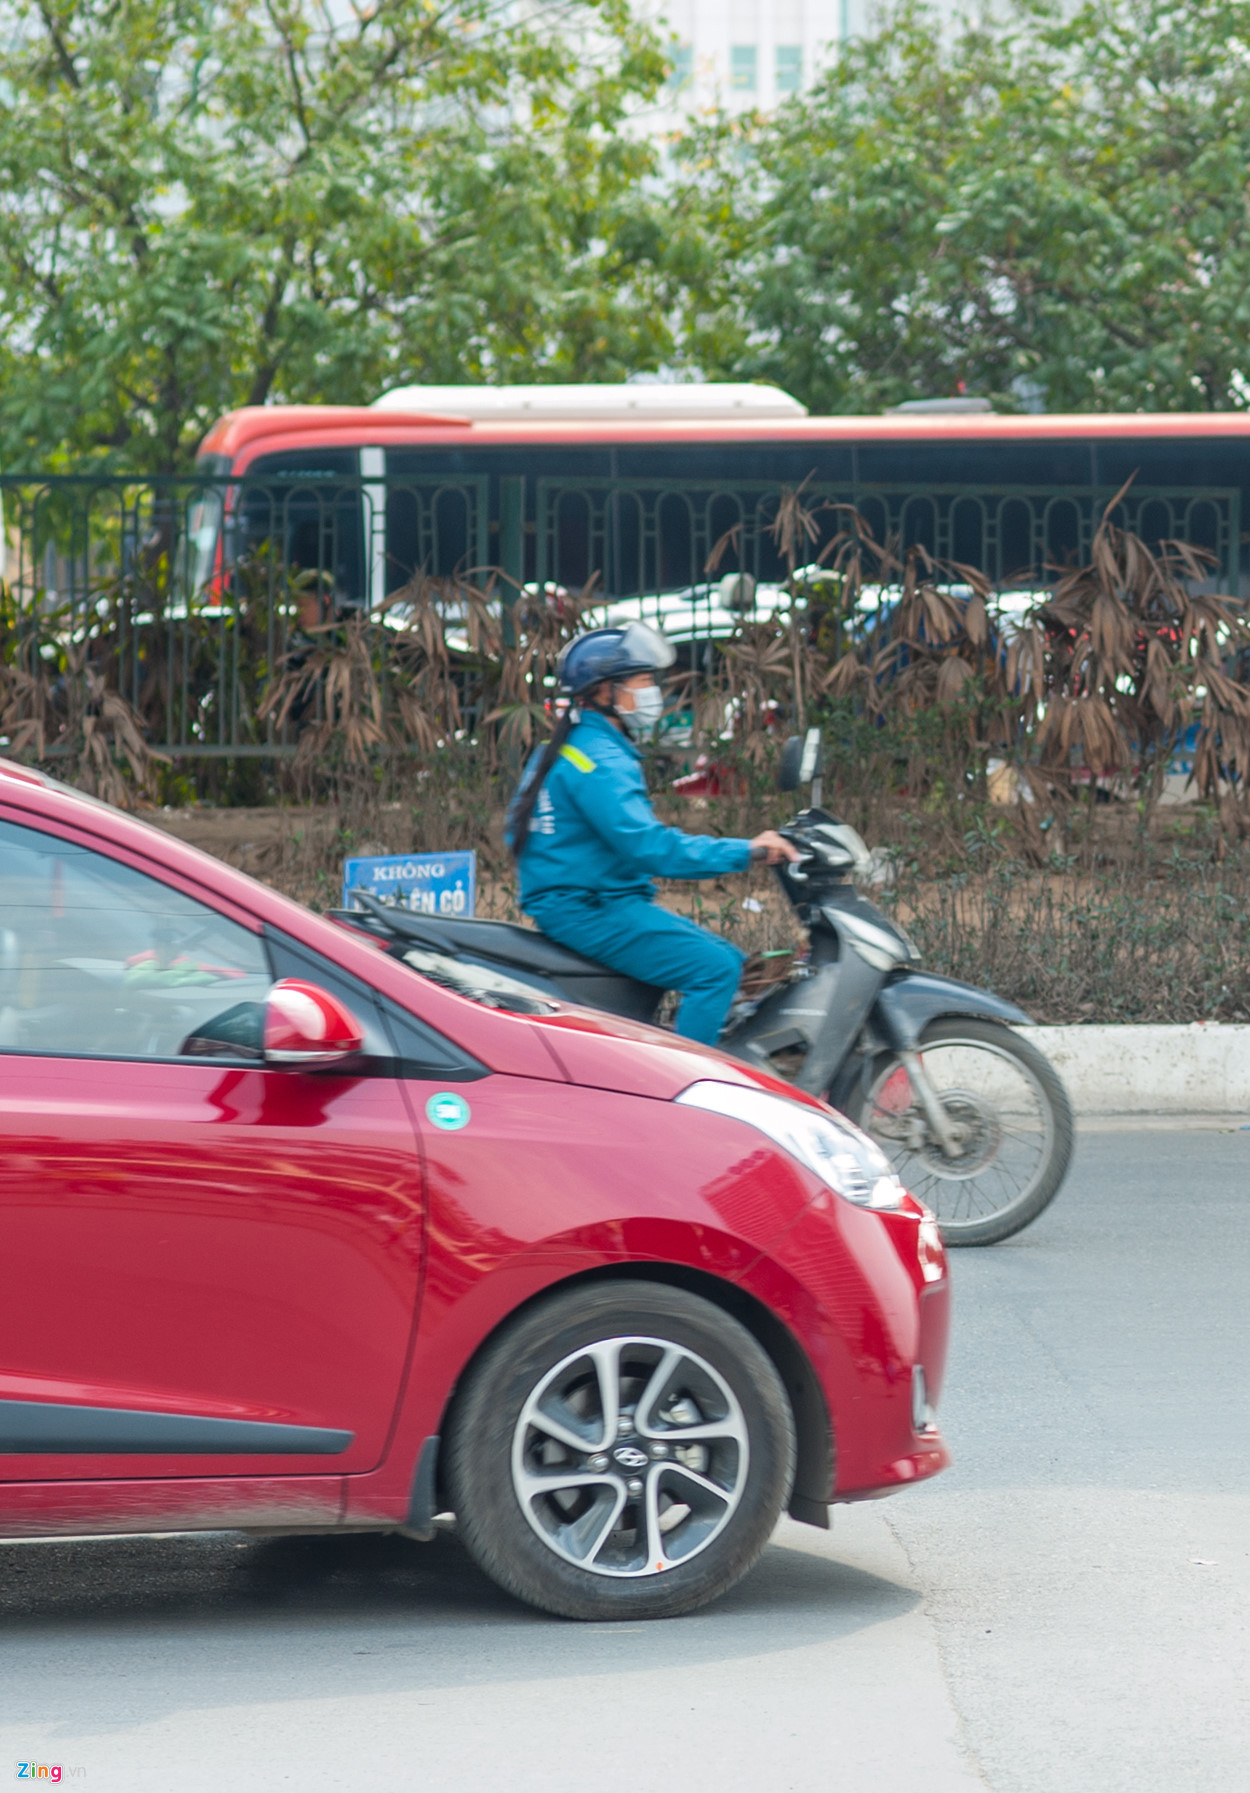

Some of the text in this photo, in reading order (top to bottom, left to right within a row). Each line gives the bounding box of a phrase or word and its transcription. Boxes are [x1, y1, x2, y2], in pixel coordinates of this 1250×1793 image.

[373, 862, 446, 881] KHÔNG
[400, 887, 436, 914] ÊN
[440, 879, 466, 913] CỎ
